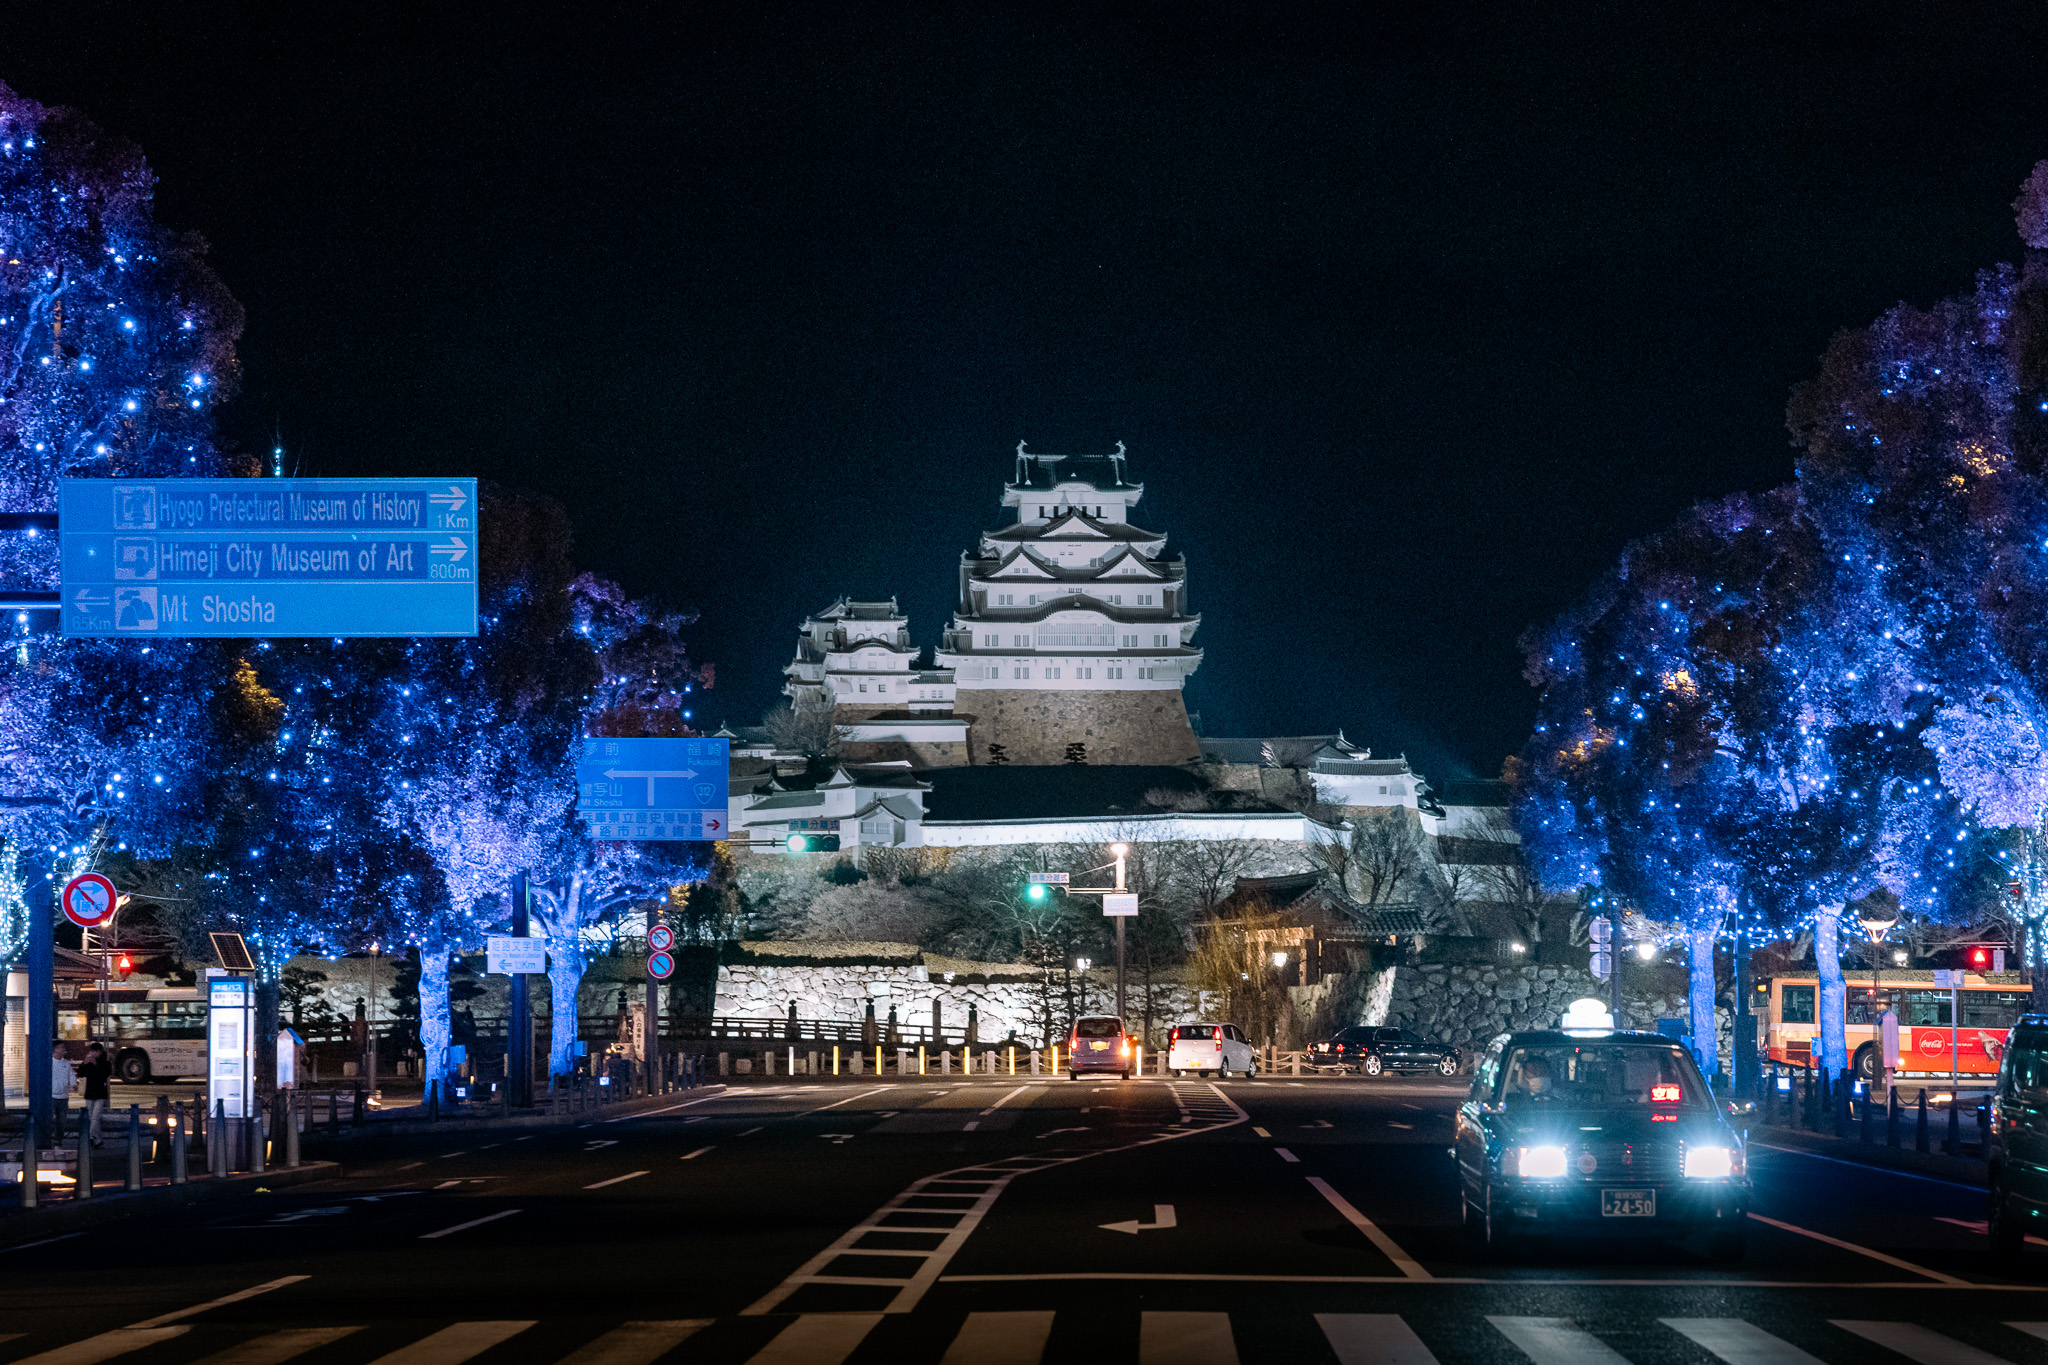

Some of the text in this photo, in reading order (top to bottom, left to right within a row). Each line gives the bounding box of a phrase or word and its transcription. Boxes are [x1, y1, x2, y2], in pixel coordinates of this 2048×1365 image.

[160, 492, 420, 527] Hyogo Prefectural Museum of History
[161, 543, 413, 578] Himeji City Museum of Art
[430, 564, 470, 579] 800m
[202, 594, 275, 623] Shosha
[687, 742, 722, 756] 福崎
[687, 758, 722, 766] Fukusaki
[581, 782, 623, 797] 書写山
[699, 786, 711, 796] 312
[594, 798, 623, 807] Shosha
[582, 812, 703, 824] 兵庫県立歴史博物館
[790, 819, 839, 829] 歩車分離式
[1652, 1086, 1680, 1101] 空車
[1613, 1200, 1652, 1214] 24-50
